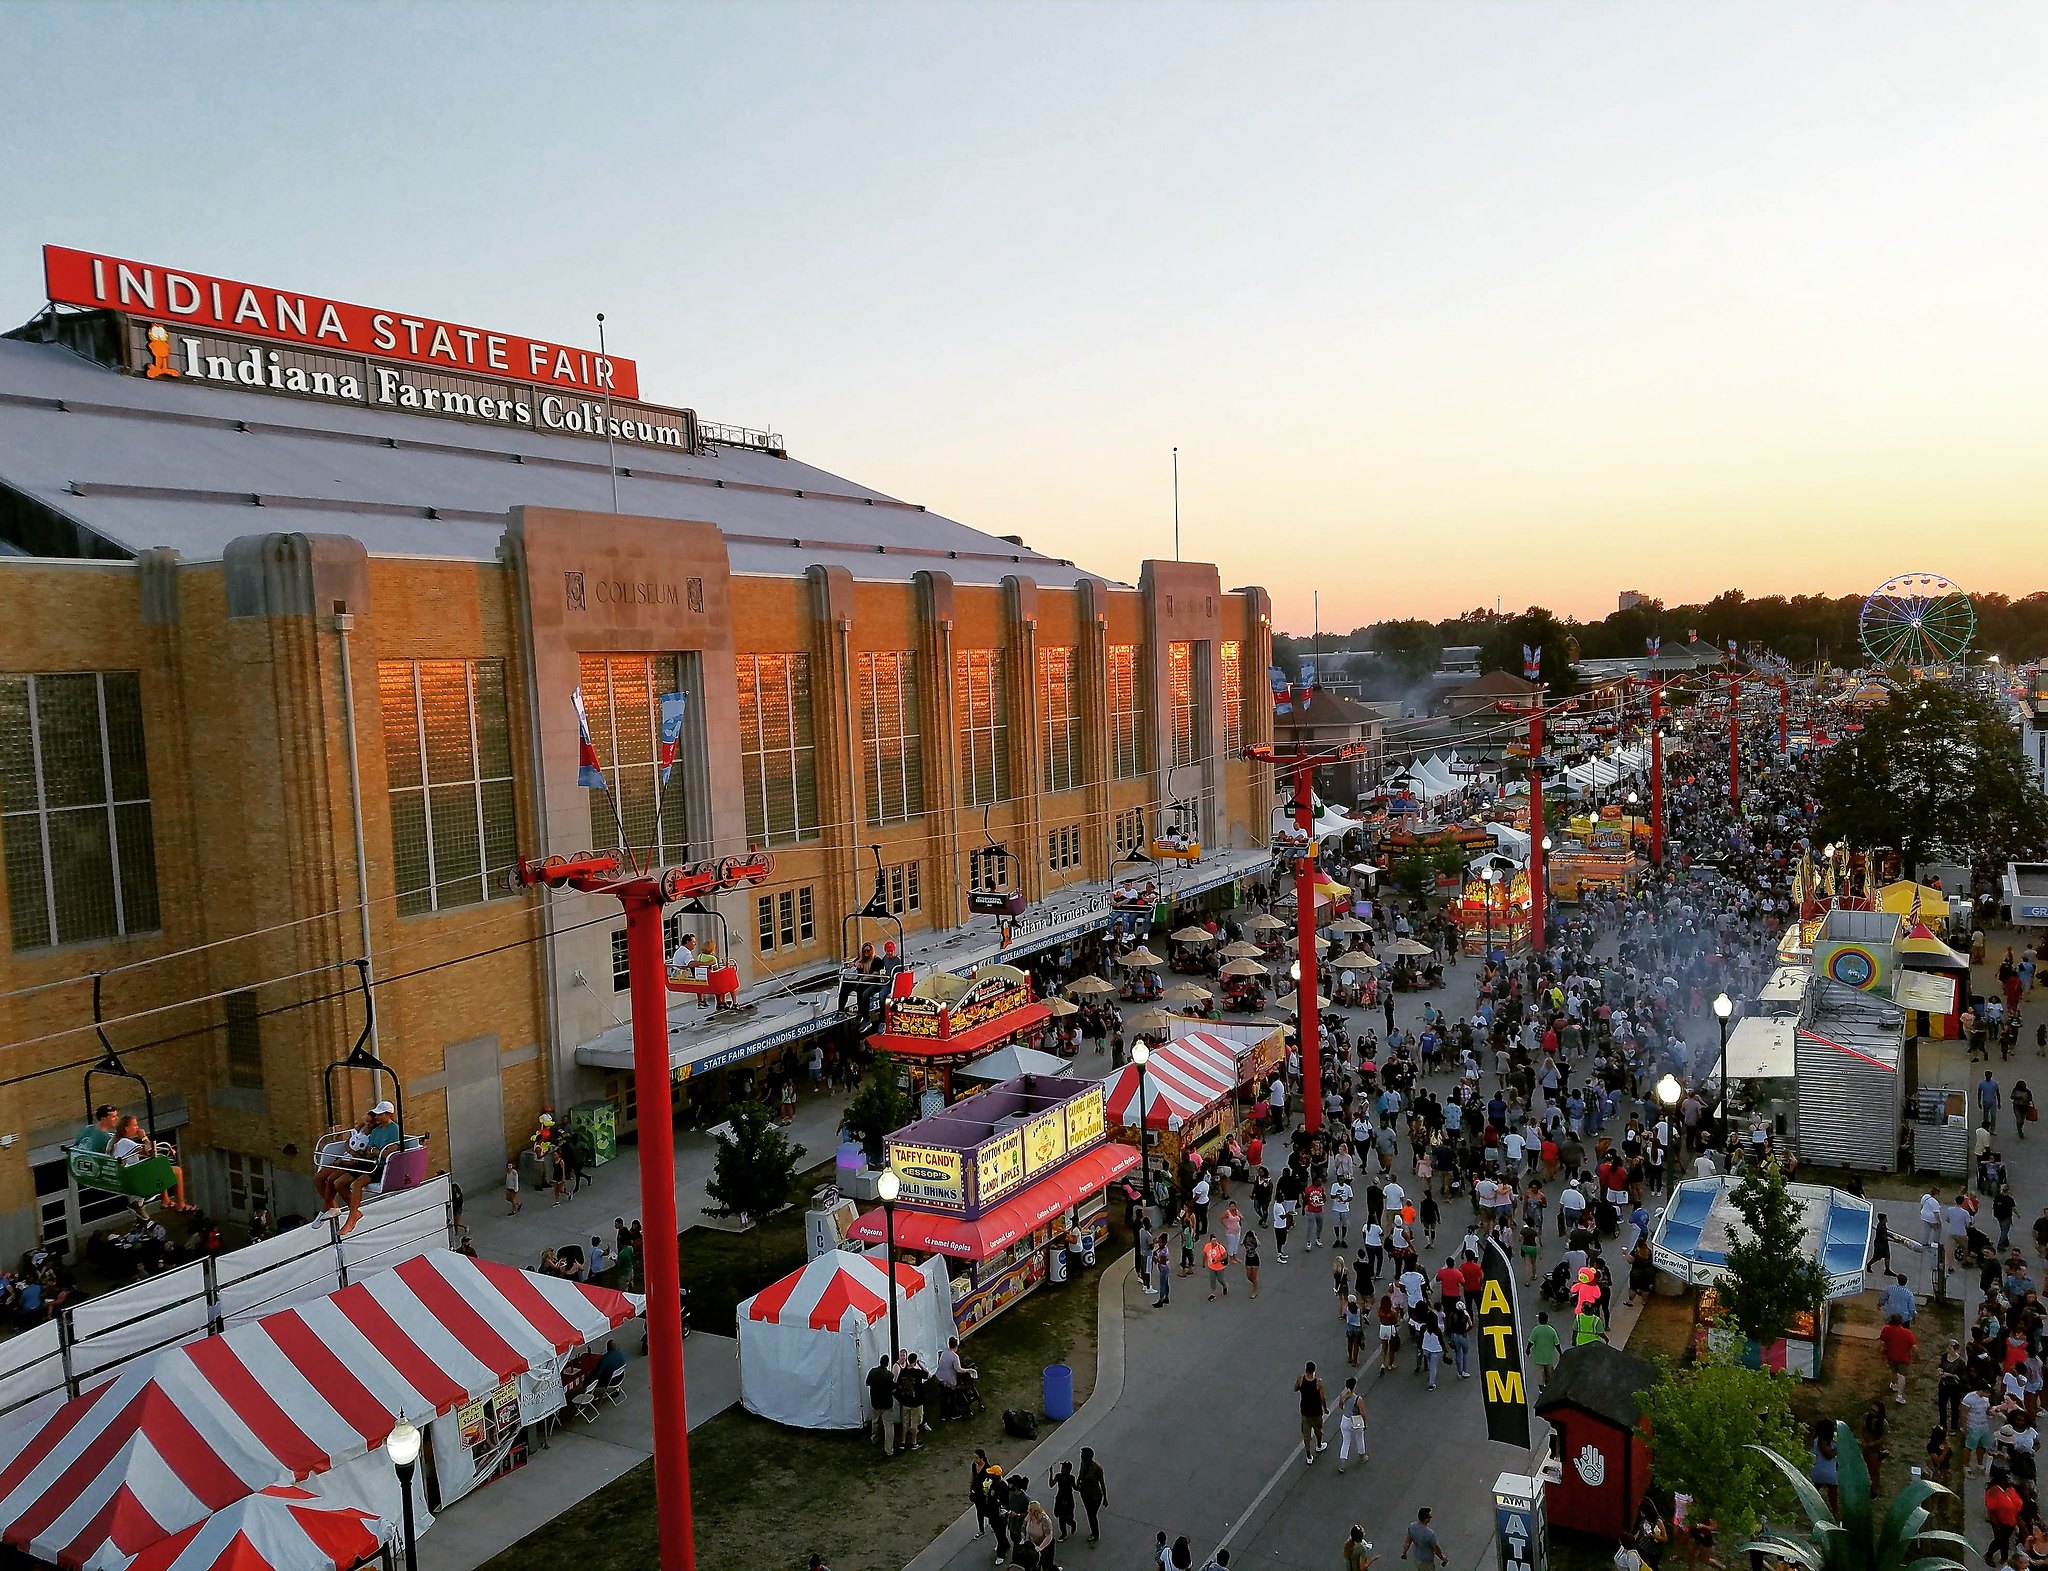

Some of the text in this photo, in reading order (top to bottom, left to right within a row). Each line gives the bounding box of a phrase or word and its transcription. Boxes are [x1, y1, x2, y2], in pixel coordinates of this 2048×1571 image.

[93, 258, 616, 390] INDIANA STATE FAIR
[181, 337, 684, 448] Indiana Farmers Coliseum
[595, 580, 680, 606] COLISEUM
[1011, 894, 1111, 940] Indiana Farmers Coli
[703, 1053, 728, 1071] STATE
[728, 1048, 745, 1062] FAIR
[746, 1029, 797, 1059] MERCHANDISE
[797, 1021, 816, 1036] SOLD
[1086, 1092, 1100, 1110] APPLES
[1069, 1119, 1102, 1147] POPCORN
[895, 1148, 955, 1168] TAFFY CANDY
[981, 1147, 1002, 1165] COTTON
[1002, 1135, 1019, 1153] CANDY
[903, 1167, 948, 1180] JESSOP'S
[982, 1165, 1020, 1195] CANDY APPLES
[923, 1184, 958, 1200] DRINKS
[1047, 1201, 1061, 1215] Candy
[859, 1226, 883, 1237] Popcorn
[924, 1236, 972, 1252] Caramel Apples
[1653, 1257, 1688, 1271] Engraving
[1654, 1250, 1670, 1260] Free
[1827, 1276, 1861, 1296] graving
[1479, 1279, 1525, 1404] ATM
